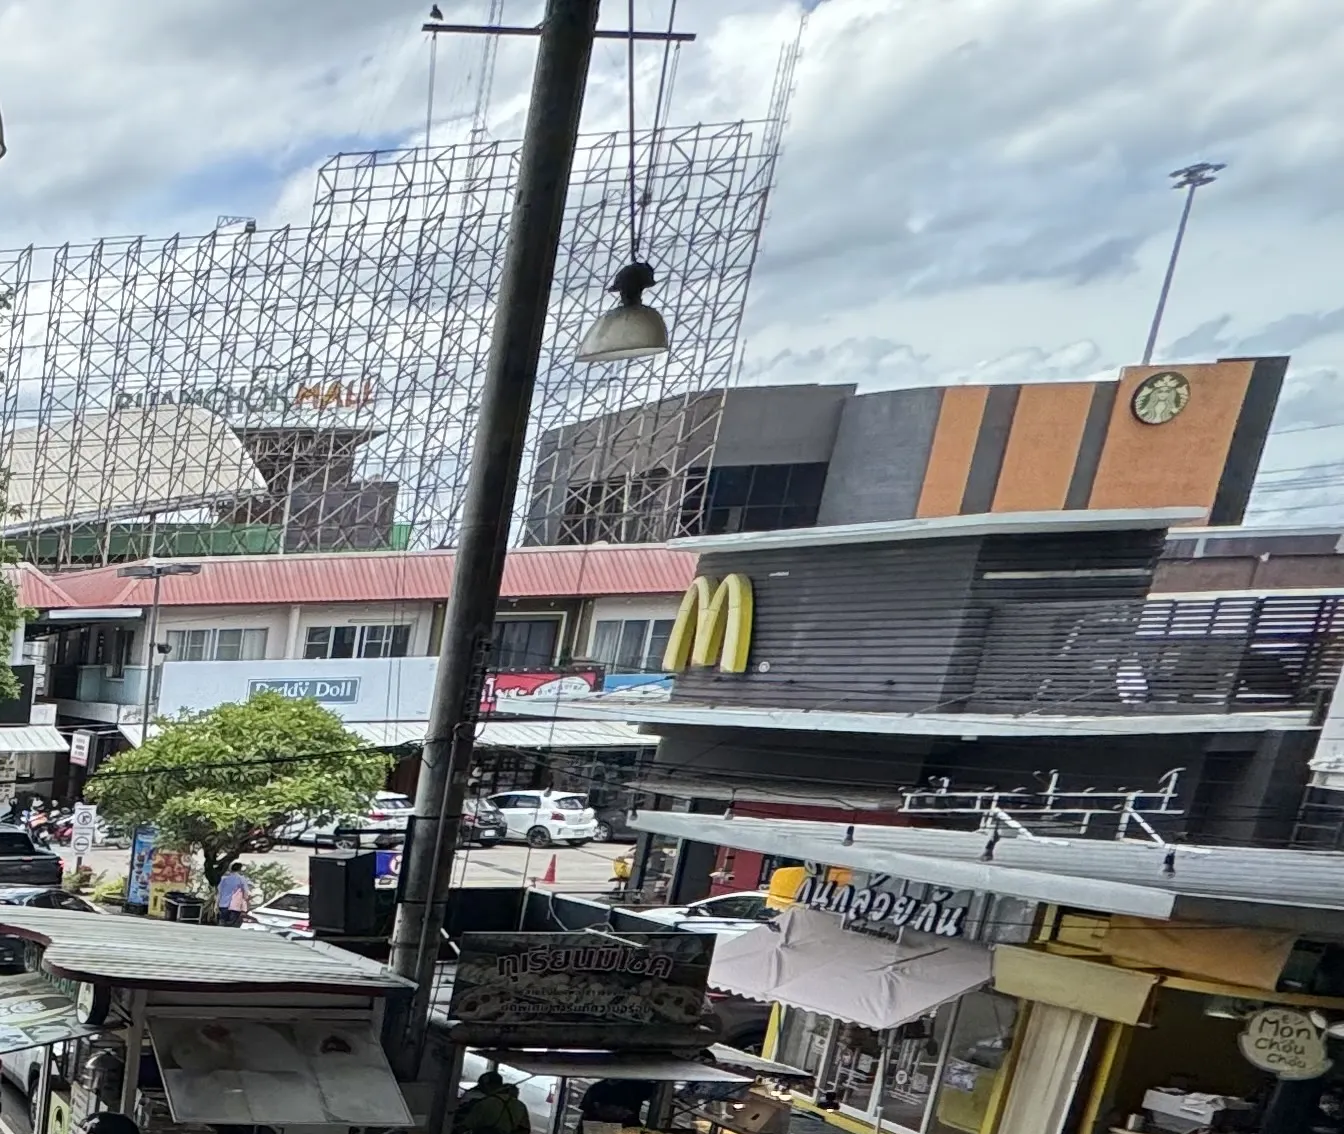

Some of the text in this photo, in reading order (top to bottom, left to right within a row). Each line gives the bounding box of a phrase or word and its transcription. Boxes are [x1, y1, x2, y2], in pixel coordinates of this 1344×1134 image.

[315, 681, 351, 697] Doll
[497, 943, 674, 981] ทุเรียนมีโชค
[1258, 1017, 1311, 1040] Mon
